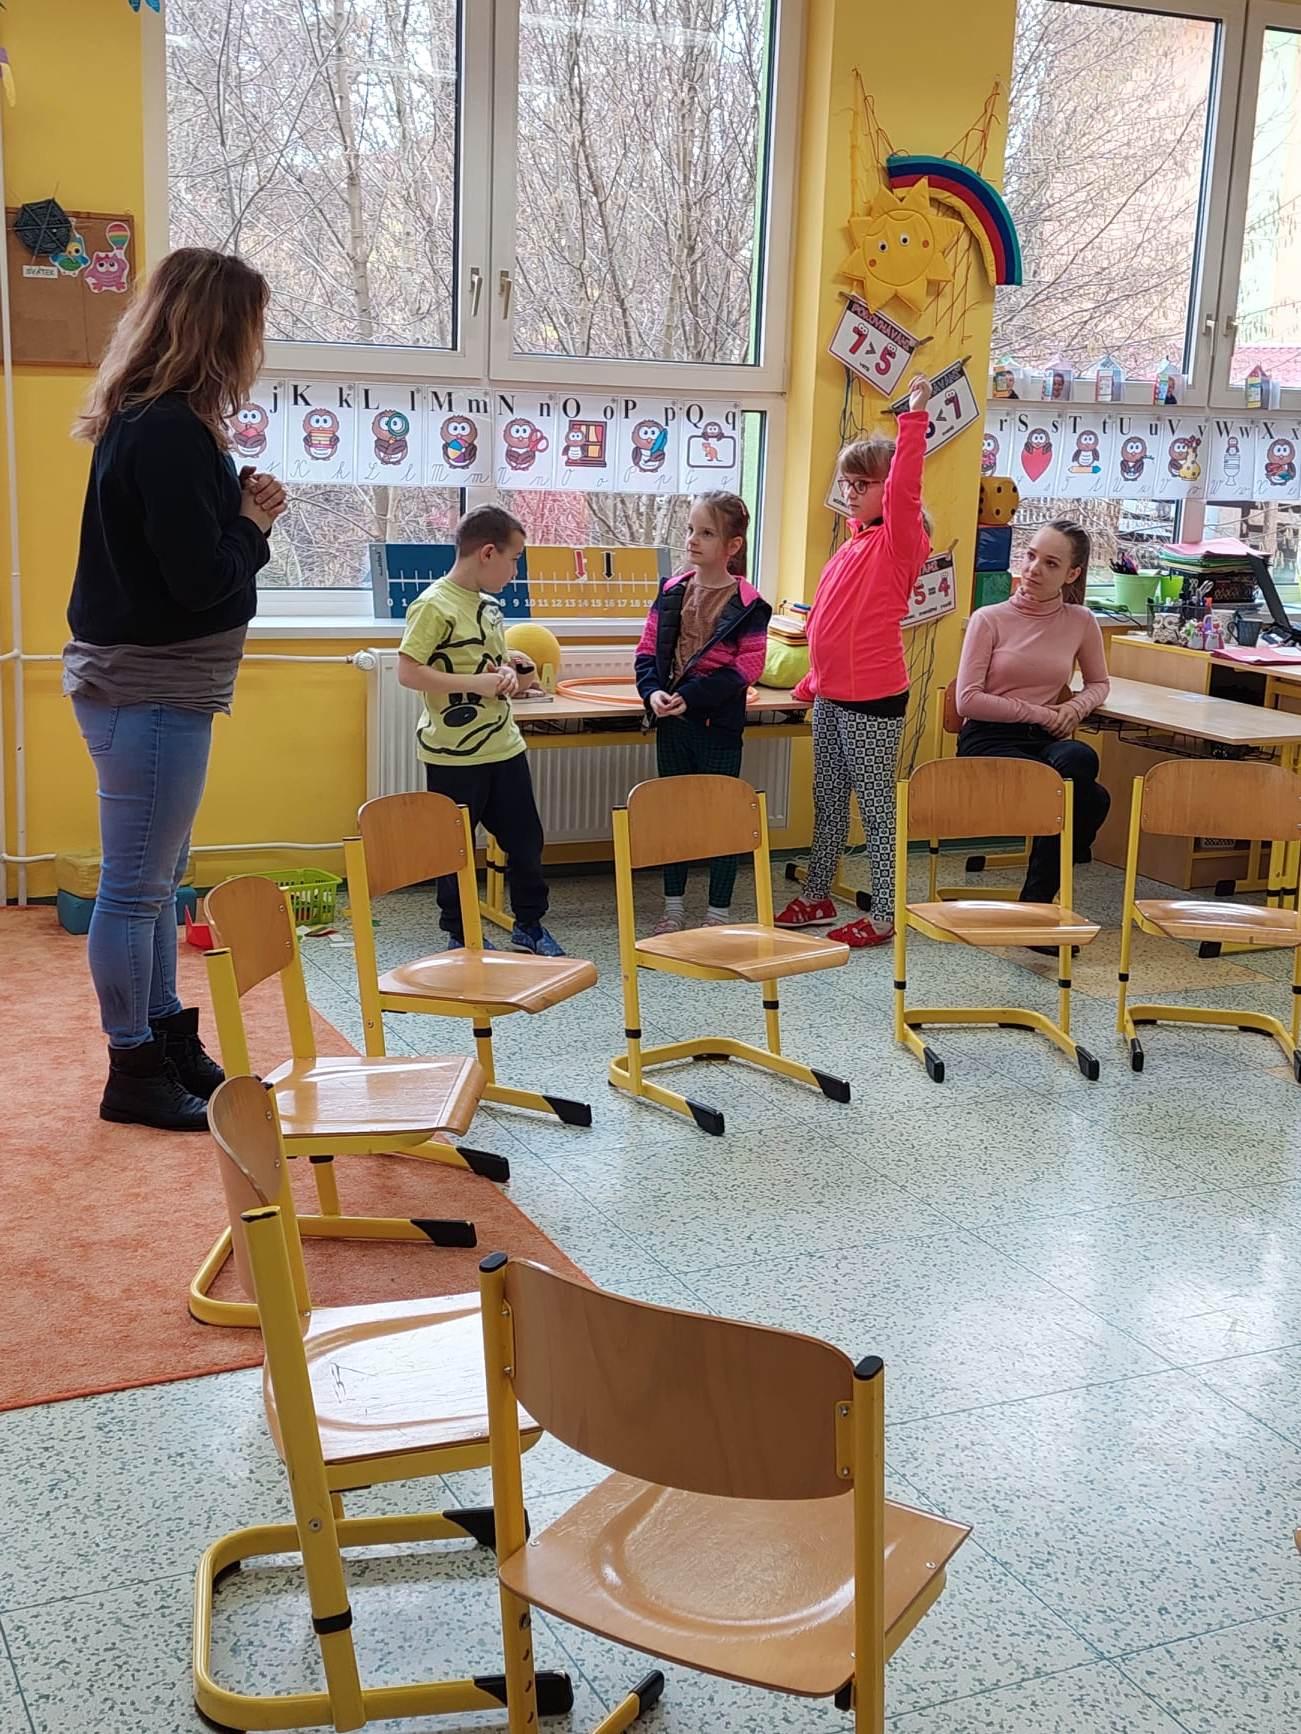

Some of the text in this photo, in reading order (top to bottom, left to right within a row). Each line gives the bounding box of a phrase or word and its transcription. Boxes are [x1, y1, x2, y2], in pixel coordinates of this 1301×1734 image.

[849, 324, 869, 354] 7
[875, 343, 897, 375] 5
[270, 386, 278, 413] j
[291, 384, 353, 409] K k
[363, 389, 380, 410] L
[430, 391, 489, 414] M m
[498, 395, 551, 417] N n
[945, 390, 961, 419] 7
[562, 398, 614, 420] O o
[623, 399, 676, 427] P p
[686, 403, 737, 430] Q q
[999, 418, 1008, 432] r
[1017, 414, 1059, 433] S s
[1068, 416, 1108, 434] T t
[1119, 417, 1158, 436] U u
[1167, 419, 1208, 437] V v
[1215, 421, 1252, 438] W w
[1262, 422, 1300, 440] X x
[913, 579, 926, 605] 5
[938, 573, 950, 597] 4
[387, 598, 393, 606] 0
[402, 599, 408, 607] 1
[513, 599, 519, 607] 9
[525, 599, 535, 607] 10
[538, 599, 547, 607] 11
[552, 599, 562, 607] 12
[566, 599, 576, 607] 13
[579, 599, 588, 607] 14
[591, 599, 602, 607] 15
[605, 599, 615, 607] 16
[618, 599, 627, 607] 17
[631, 599, 640, 607] 18
